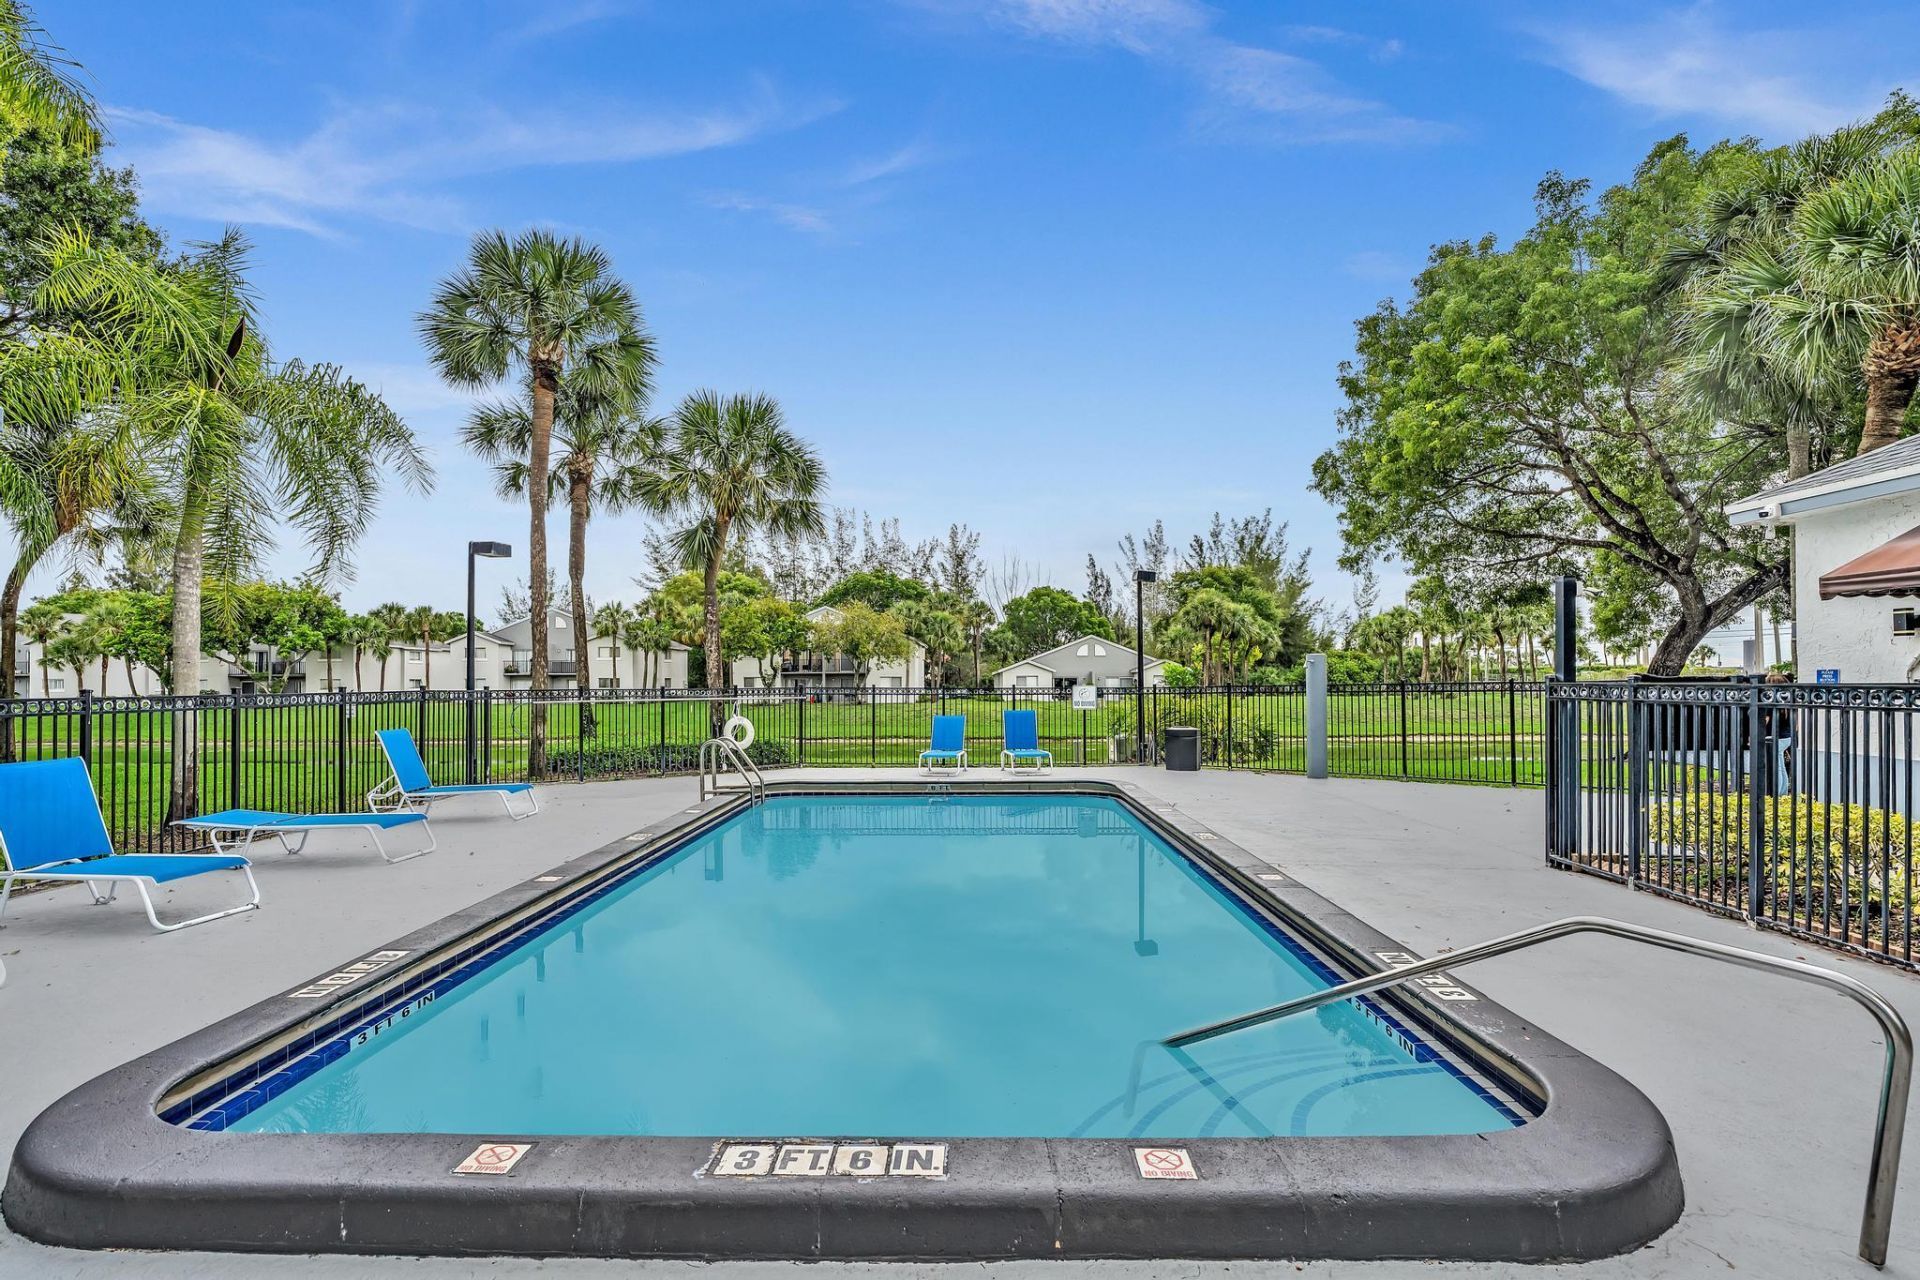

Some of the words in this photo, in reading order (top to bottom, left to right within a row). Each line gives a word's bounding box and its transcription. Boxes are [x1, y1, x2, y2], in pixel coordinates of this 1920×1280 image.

[358, 1032, 367, 1045] 3
[374, 1017, 393, 1035] FT
[401, 1006, 410, 1018] 6
[416, 992, 434, 1009] IN
[1355, 1000, 1361, 1011] 3
[1365, 1007, 1381, 1027] FT
[1385, 1024, 1393, 1038] 6
[1398, 1034, 1414, 1057] IN
[733, 1149, 761, 1170] 3
[778, 1149, 830, 1171] FT.
[849, 1149, 873, 1170] 6
[892, 1149, 940, 1171] IN.
[1161, 1170, 1194, 1178] DIVING
